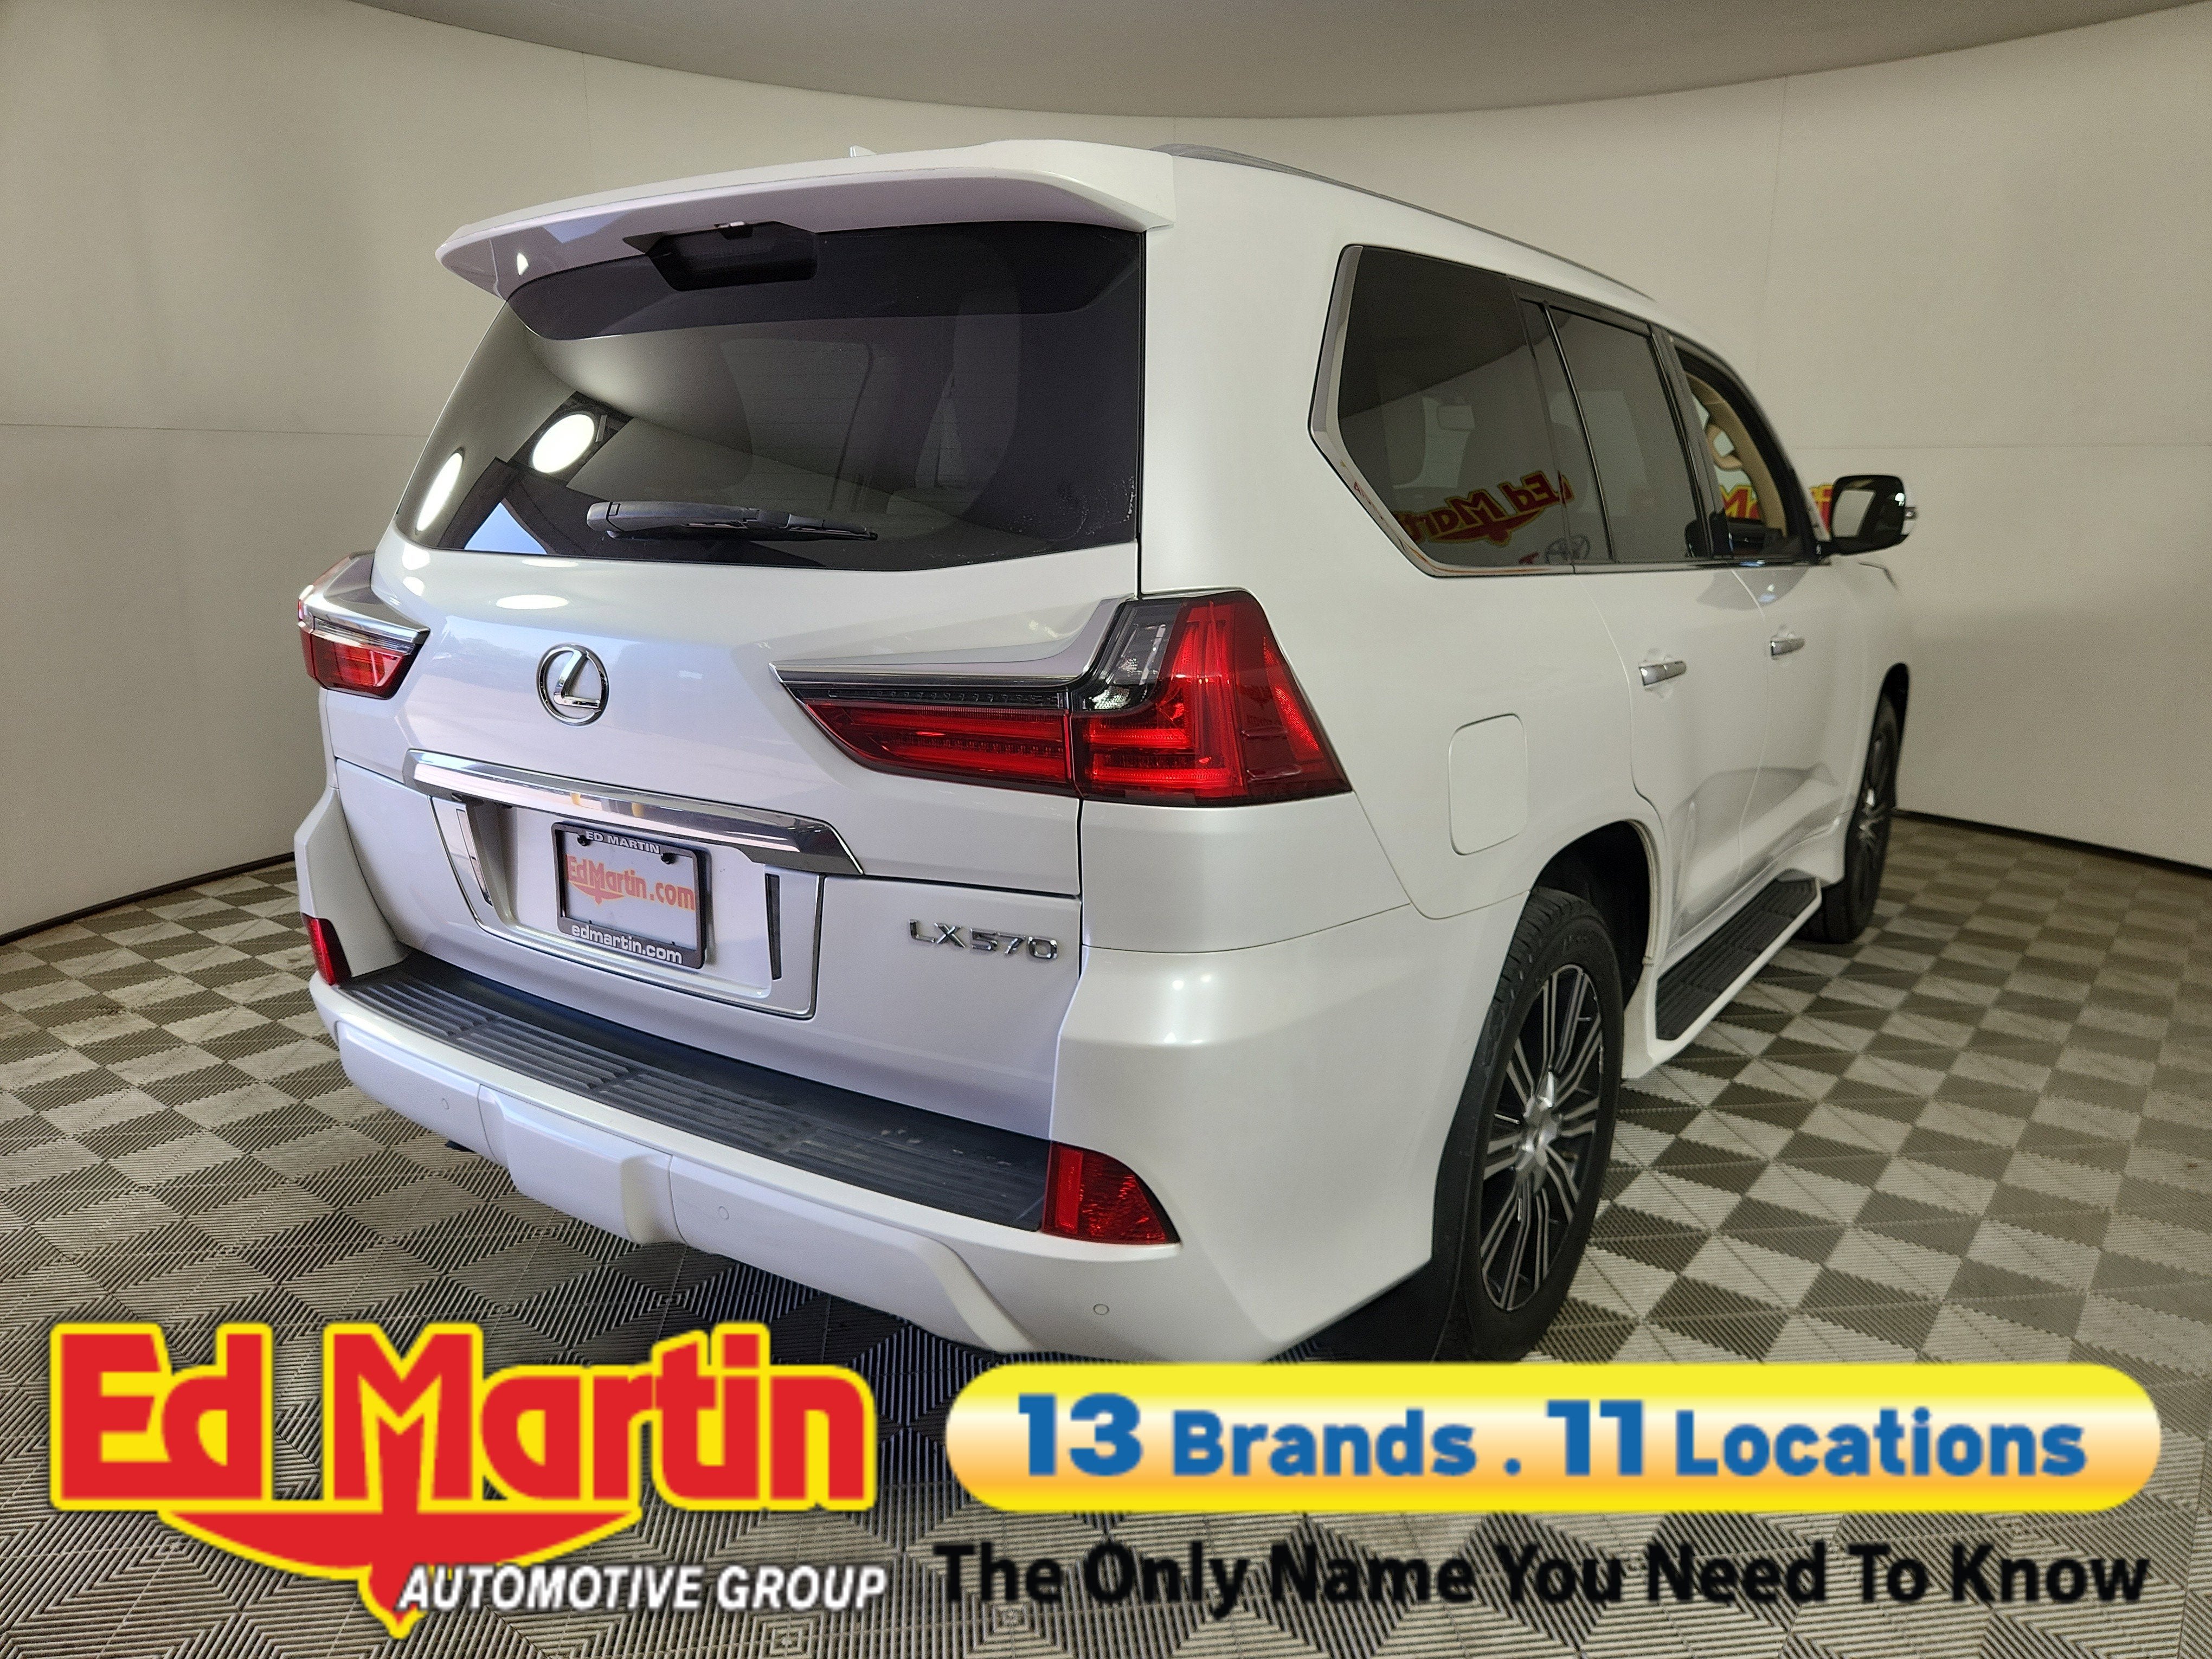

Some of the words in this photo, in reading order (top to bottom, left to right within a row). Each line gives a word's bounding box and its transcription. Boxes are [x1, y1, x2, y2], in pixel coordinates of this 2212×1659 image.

[586, 830, 604, 842] ED
[607, 835, 660, 855] MARTIN
[571, 924, 683, 964] edmartin.com
